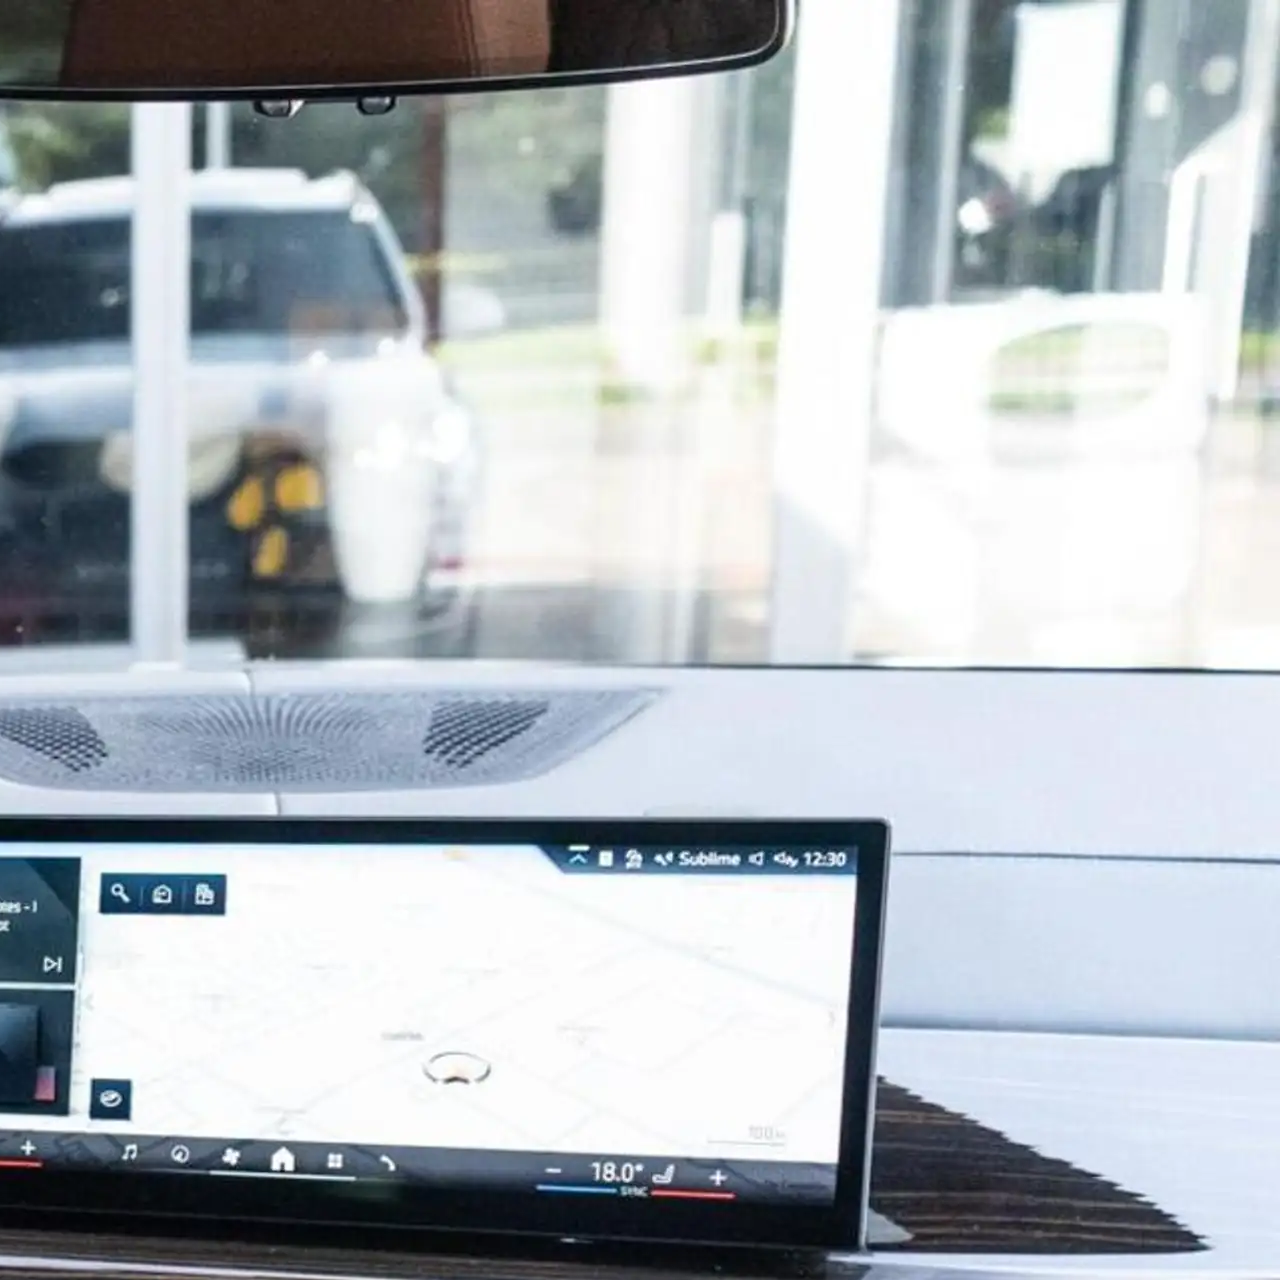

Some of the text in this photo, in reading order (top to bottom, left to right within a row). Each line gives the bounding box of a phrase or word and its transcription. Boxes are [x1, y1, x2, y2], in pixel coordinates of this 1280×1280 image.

[679, 851, 741, 866] Sublime
[804, 852, 847, 867] 12:30
[591, 1162, 644, 1183] 18.0°
